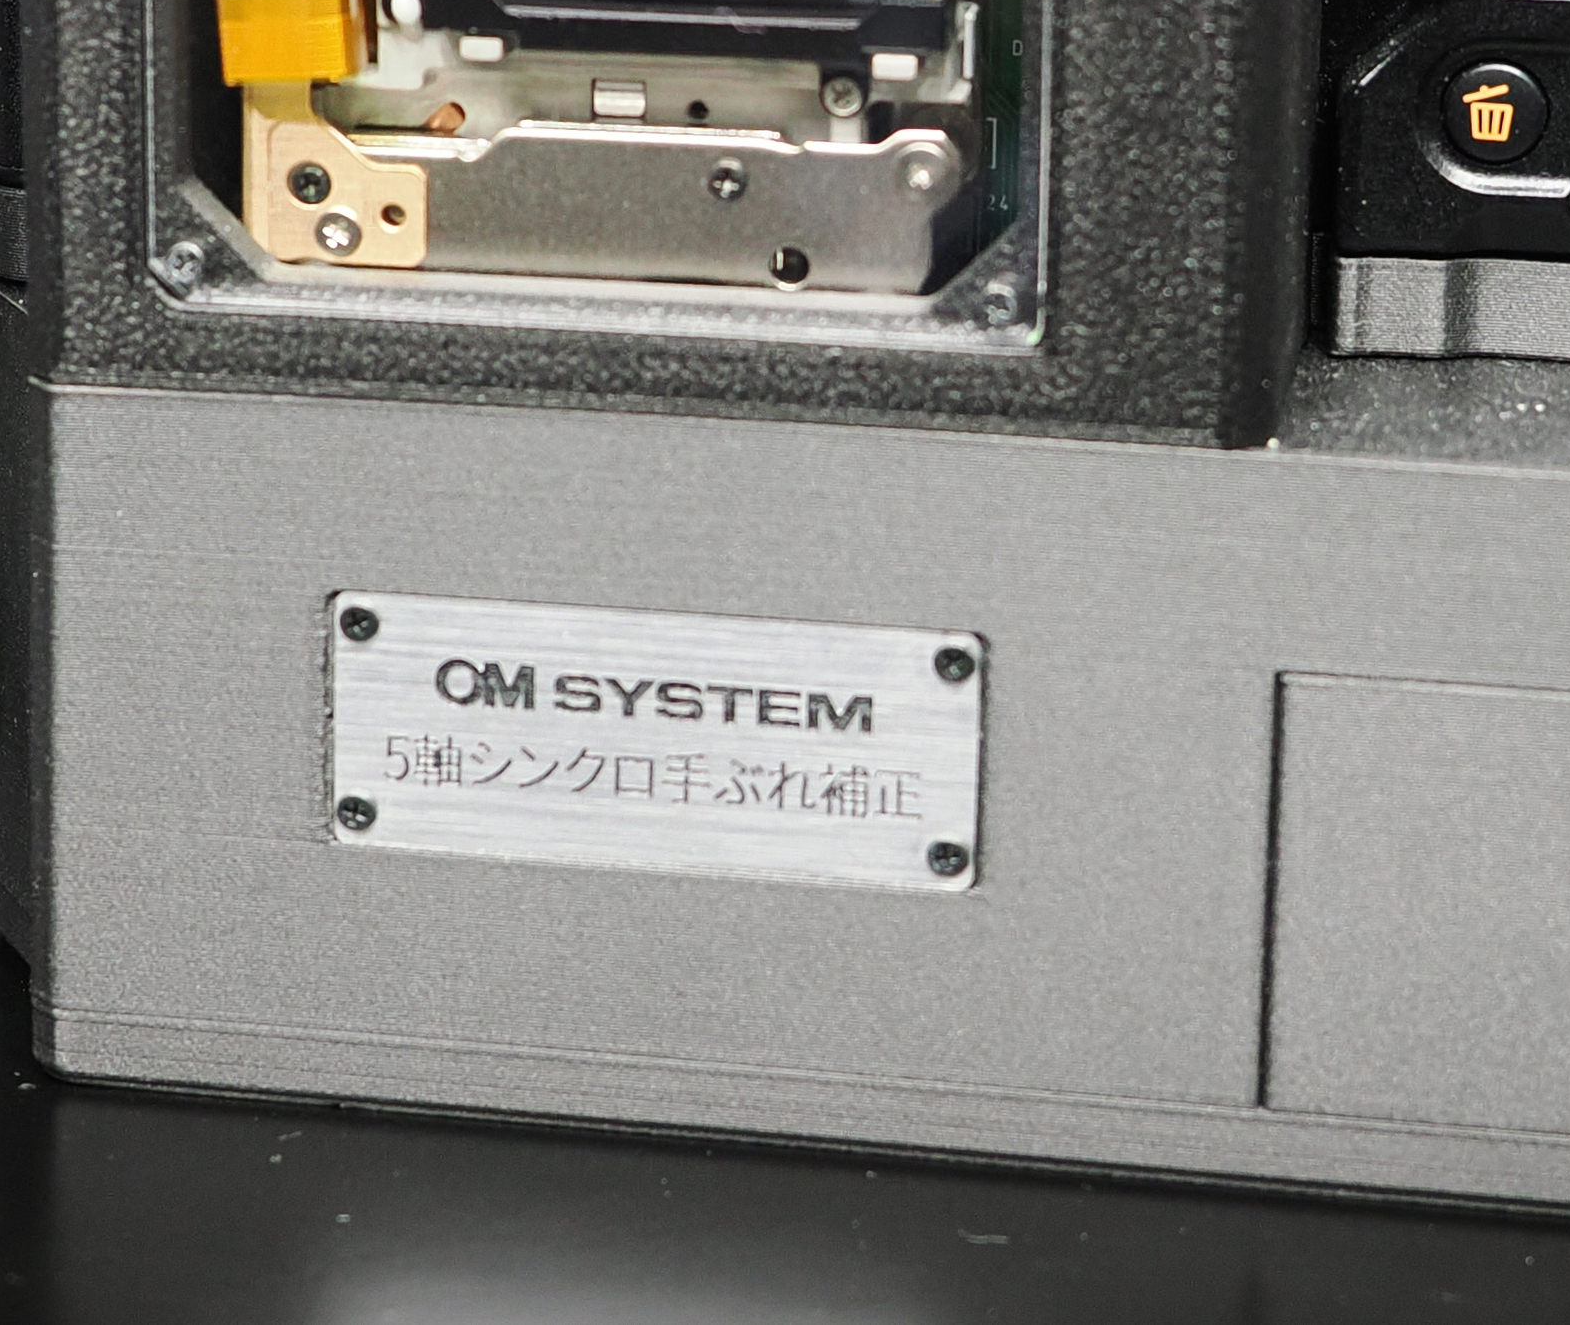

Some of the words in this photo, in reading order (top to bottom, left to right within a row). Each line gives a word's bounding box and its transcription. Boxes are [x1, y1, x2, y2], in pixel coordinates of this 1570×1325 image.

[434, 657, 536, 711] OM
[553, 673, 875, 733] SYSTEM
[383, 732, 924, 821] 5軸シンクロ手ぶれ補正
